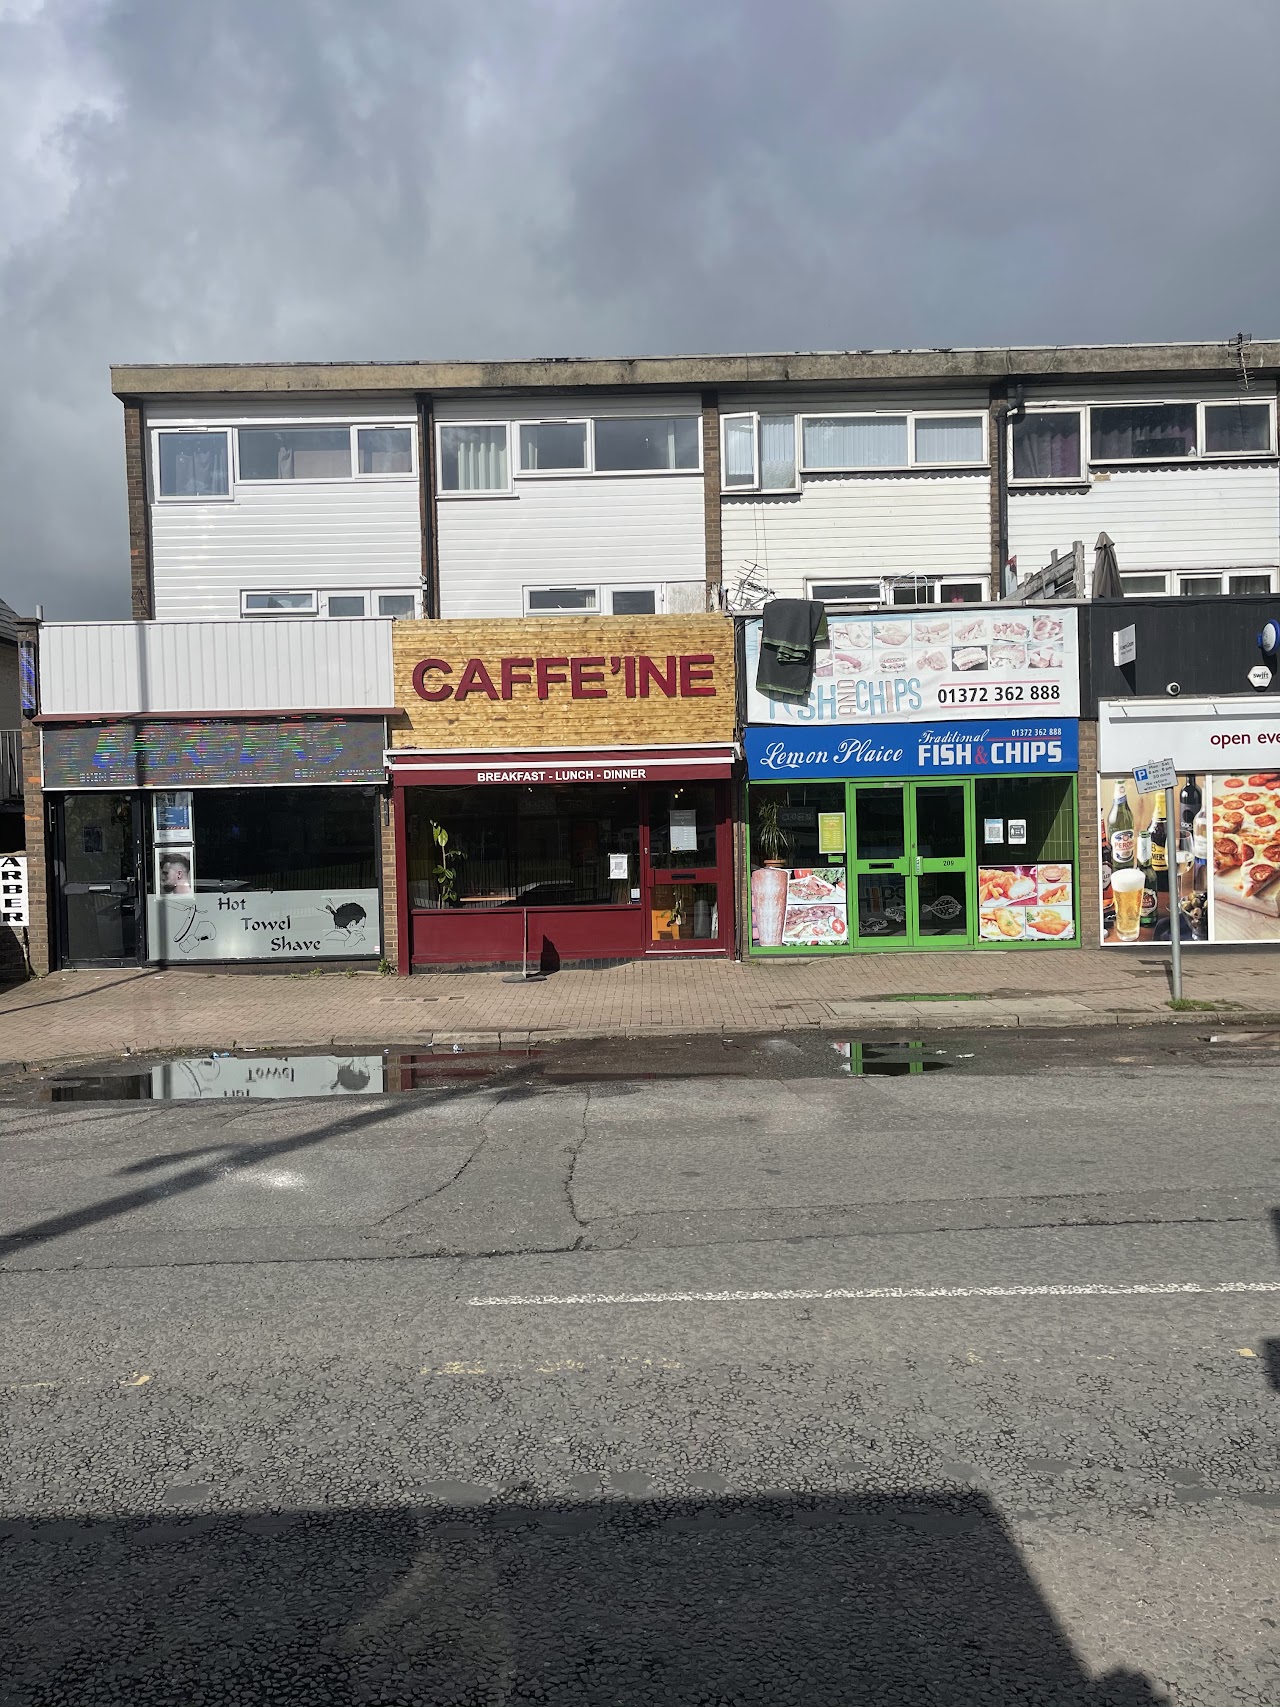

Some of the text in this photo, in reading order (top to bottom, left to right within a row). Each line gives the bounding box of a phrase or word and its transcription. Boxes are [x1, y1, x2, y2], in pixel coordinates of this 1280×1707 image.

[412, 655, 717, 702] CAFFE'INE
[855, 678, 922, 715] CHIPS
[937, 685, 1060, 703] 01372 362 888
[918, 729, 990, 743] Traditional
[1011, 728, 1061, 737] 01372 362 888
[1210, 734, 1251, 749] open
[760, 738, 904, 770] Lemon Plaice
[918, 740, 1062, 766] FISH & CHIPS
[477, 772, 546, 782] BREAKFAST
[555, 770, 594, 781] LUNCH
[603, 769, 647, 780] DINNER
[217, 897, 247, 911] Hot
[240, 915, 291, 931] Towel
[271, 936, 321, 952] Shave
